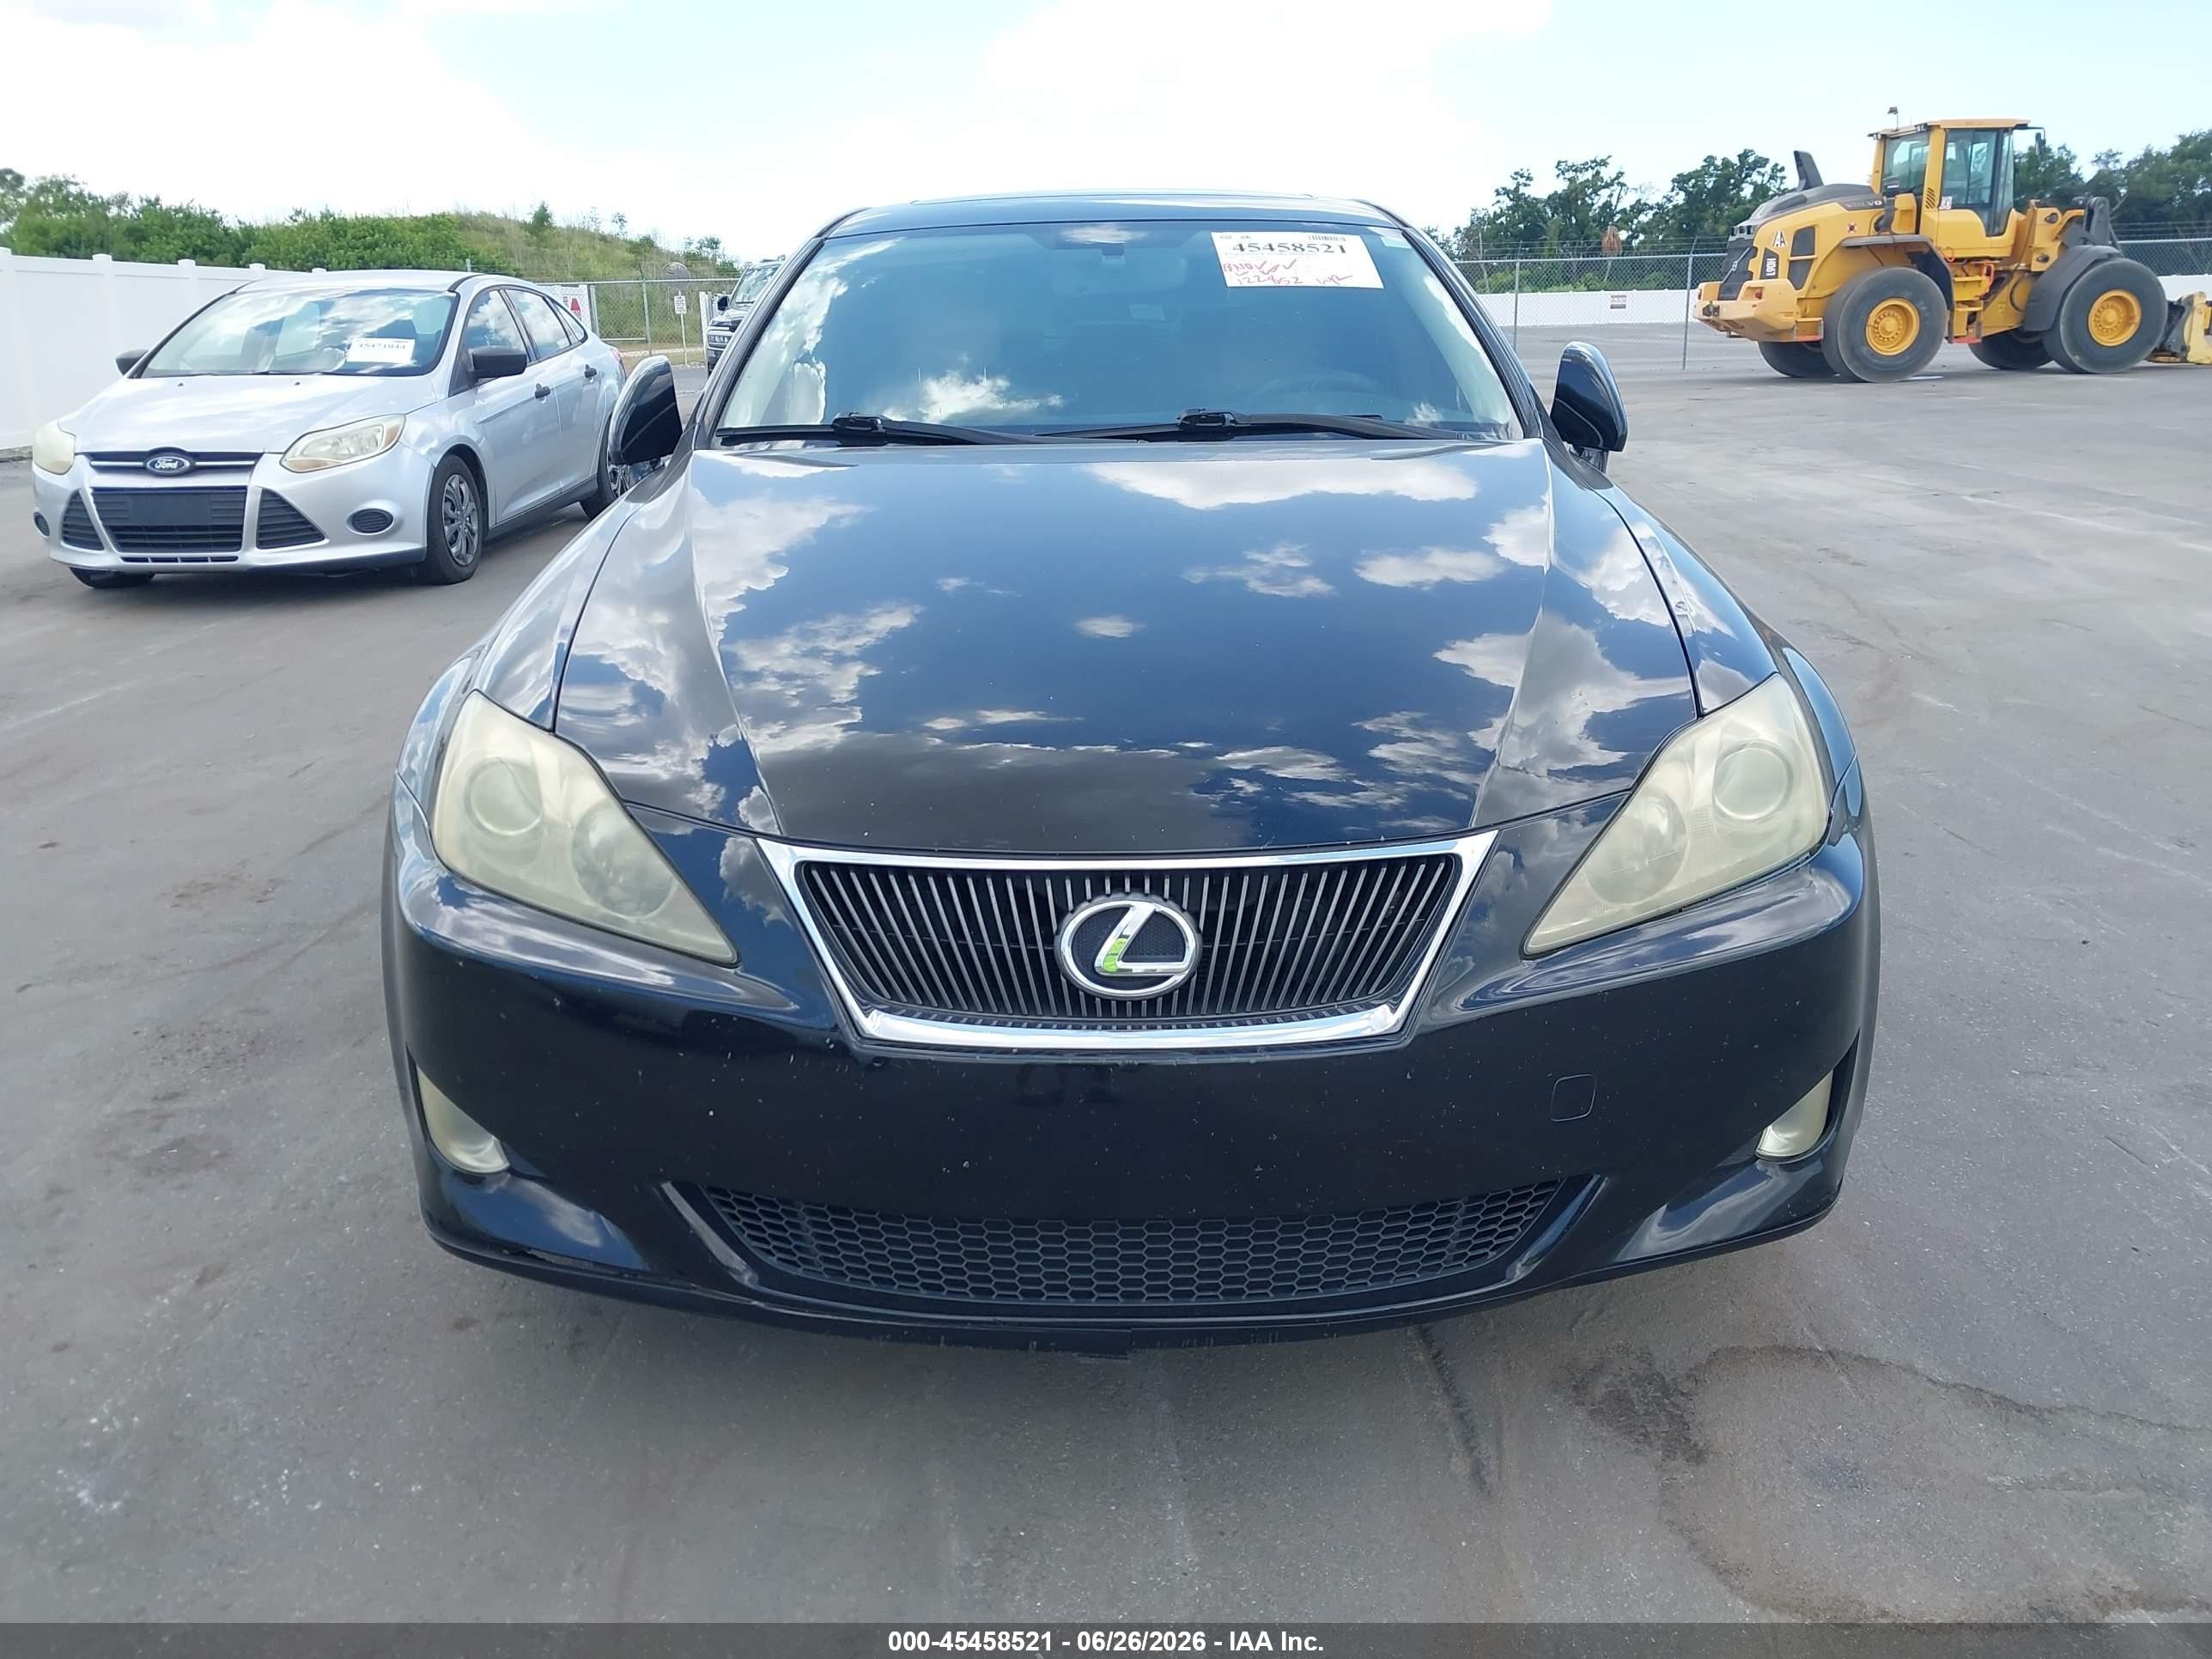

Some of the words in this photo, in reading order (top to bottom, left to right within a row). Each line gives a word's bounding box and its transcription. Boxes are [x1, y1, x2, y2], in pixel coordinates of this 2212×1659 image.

[1232, 242, 1346, 253] 45458521
[1765, 258, 1777, 276] L90H
[155, 458, 179, 469] Ford
